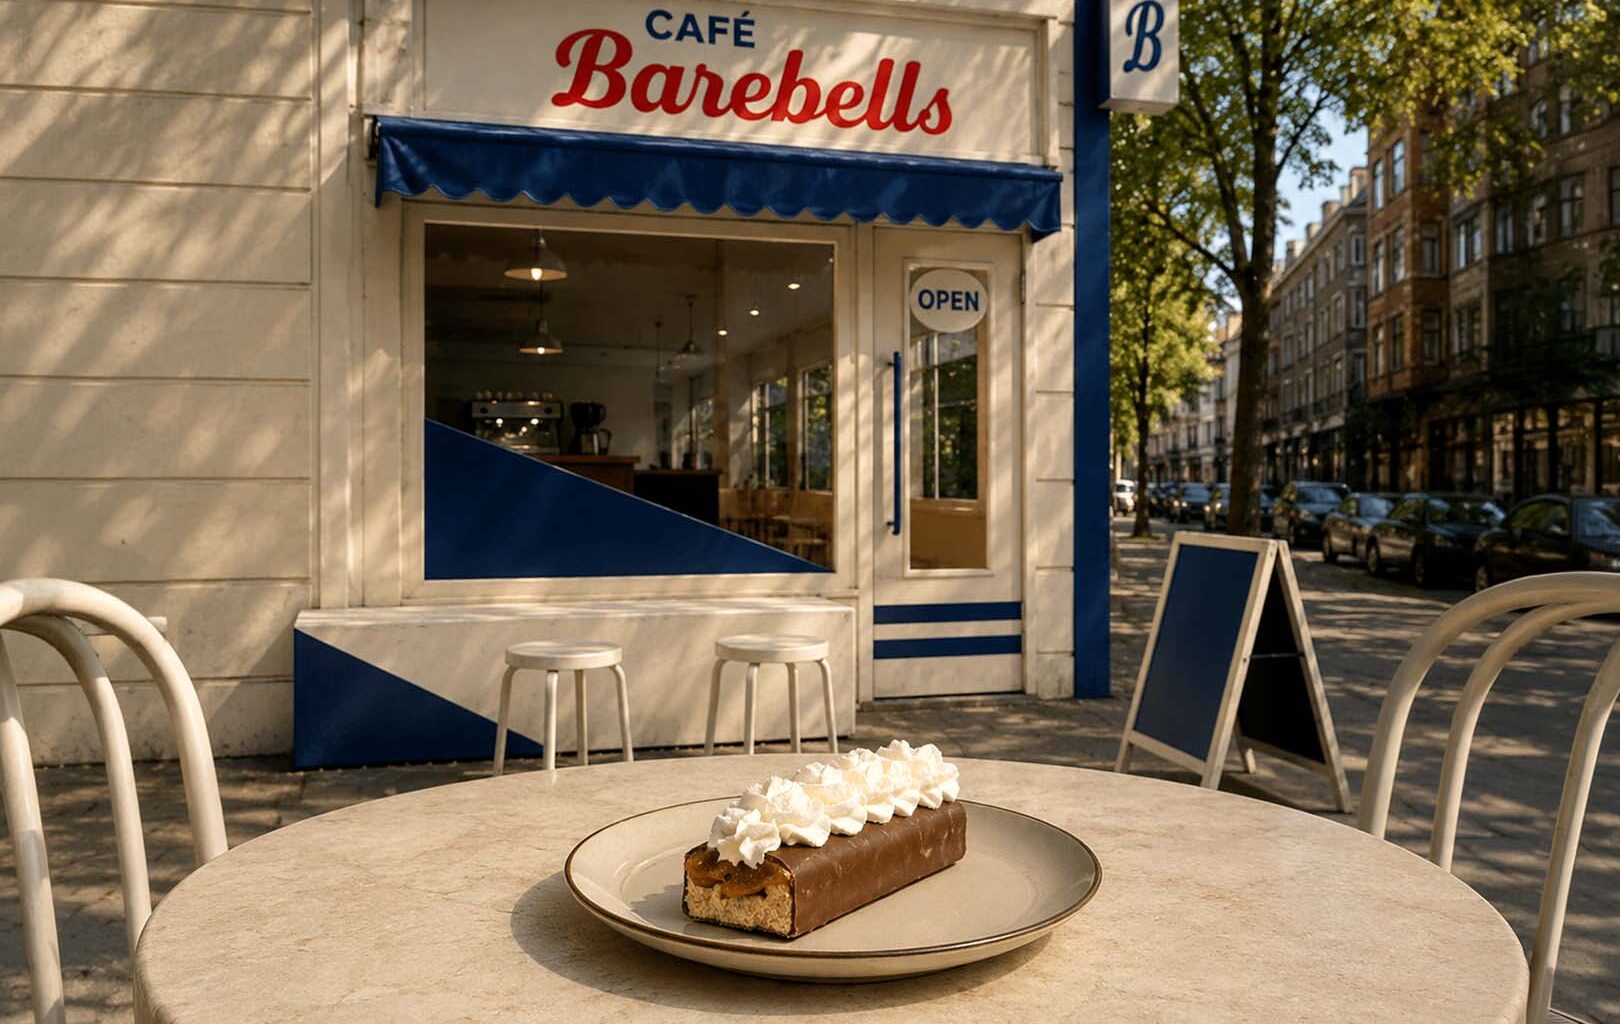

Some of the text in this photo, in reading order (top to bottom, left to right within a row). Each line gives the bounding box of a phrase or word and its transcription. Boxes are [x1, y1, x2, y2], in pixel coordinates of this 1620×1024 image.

[645, 9, 756, 49] CAFÉ
[1123, 0, 1164, 73] B
[551, 28, 953, 135] Barebells
[918, 289, 979, 311] OPEN
